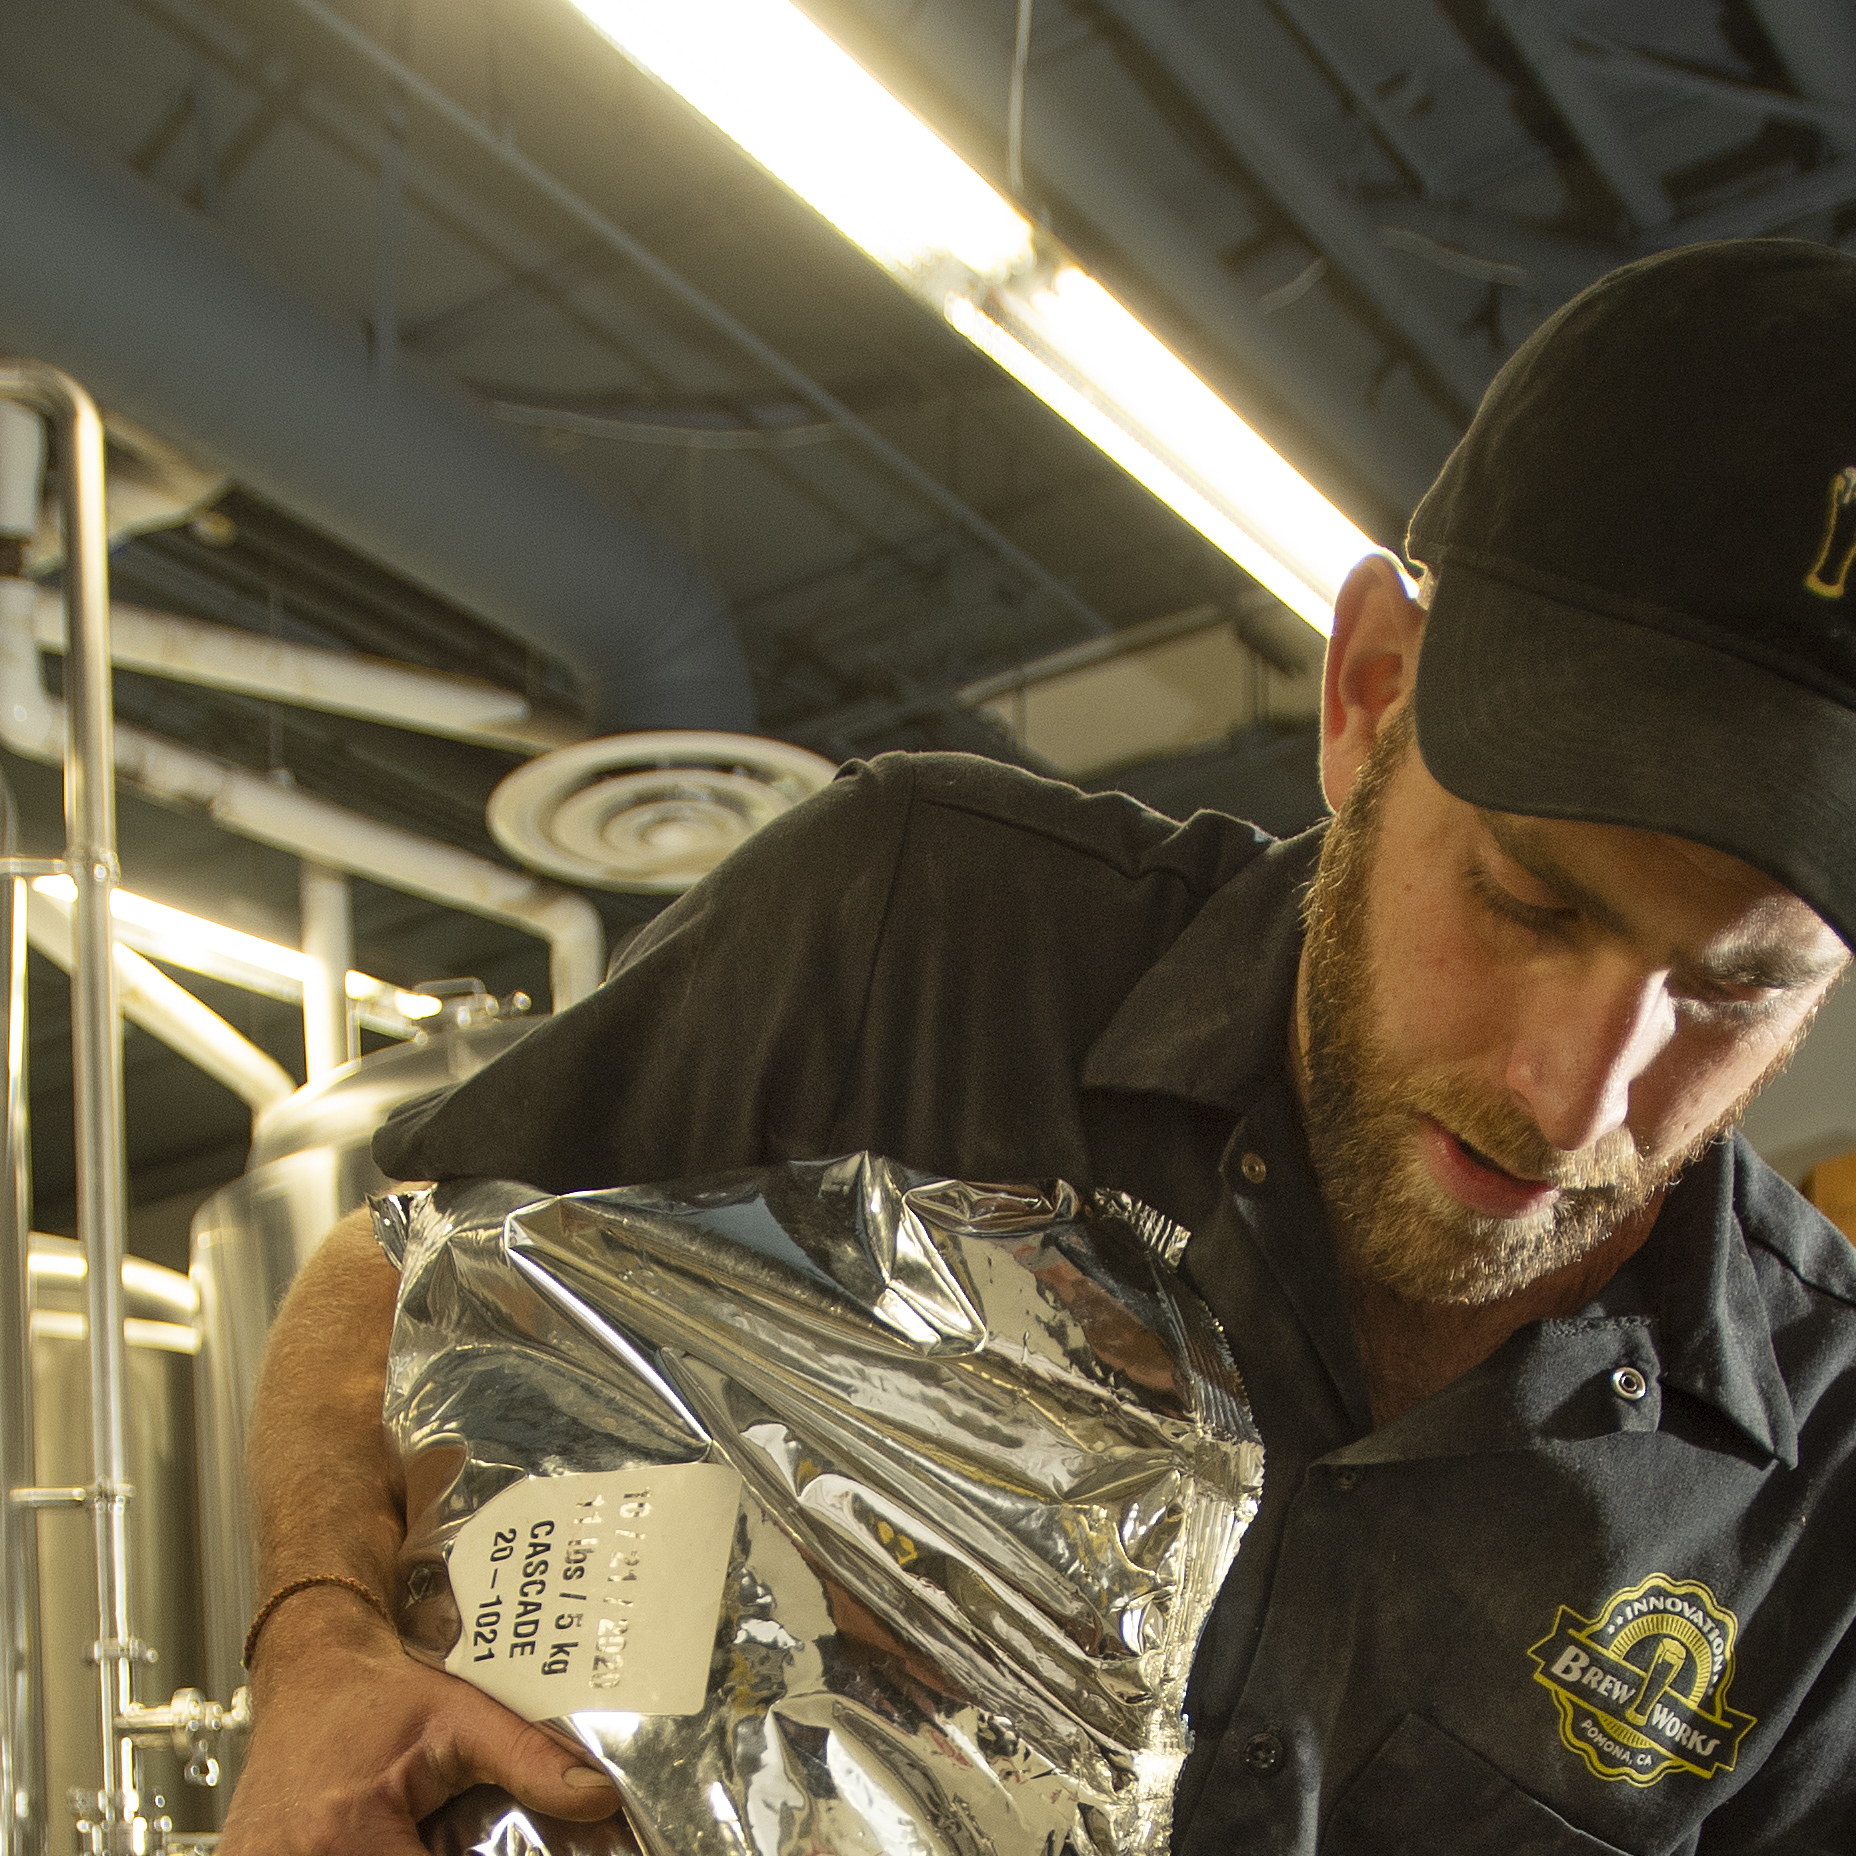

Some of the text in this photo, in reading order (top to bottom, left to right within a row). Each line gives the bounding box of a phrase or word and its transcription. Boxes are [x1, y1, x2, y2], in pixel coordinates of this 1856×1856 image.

[509, 1520, 555, 1658] CASCADE
[554, 1613, 584, 1630] 5
[1624, 1596, 1725, 1673] INNOVATION
[541, 1641, 579, 1675] kg
[1581, 1719, 1653, 1766] POMONA, CA
[1651, 1703, 1720, 1757] WORKS
